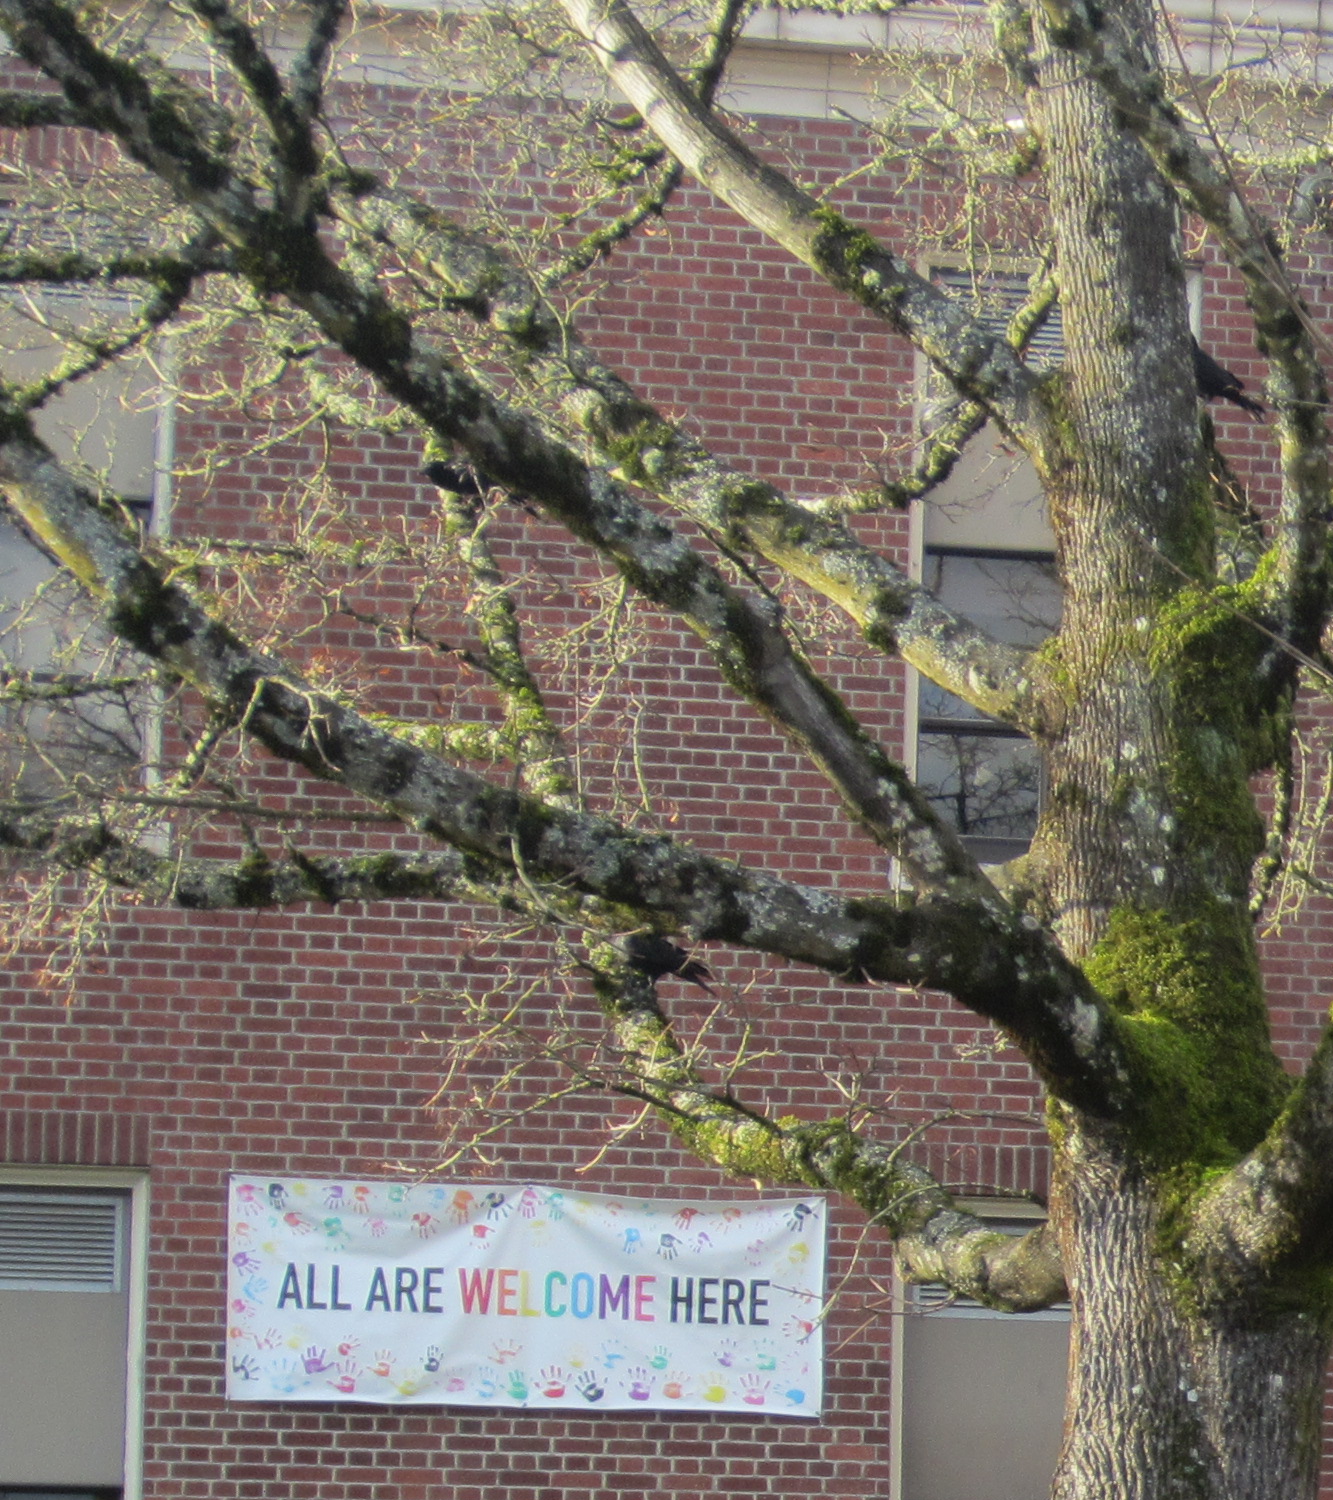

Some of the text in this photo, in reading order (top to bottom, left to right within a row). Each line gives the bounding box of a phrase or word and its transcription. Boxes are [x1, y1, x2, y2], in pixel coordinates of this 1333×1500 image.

[276, 1261, 771, 1326] ALL ARE WELCOME HERE
